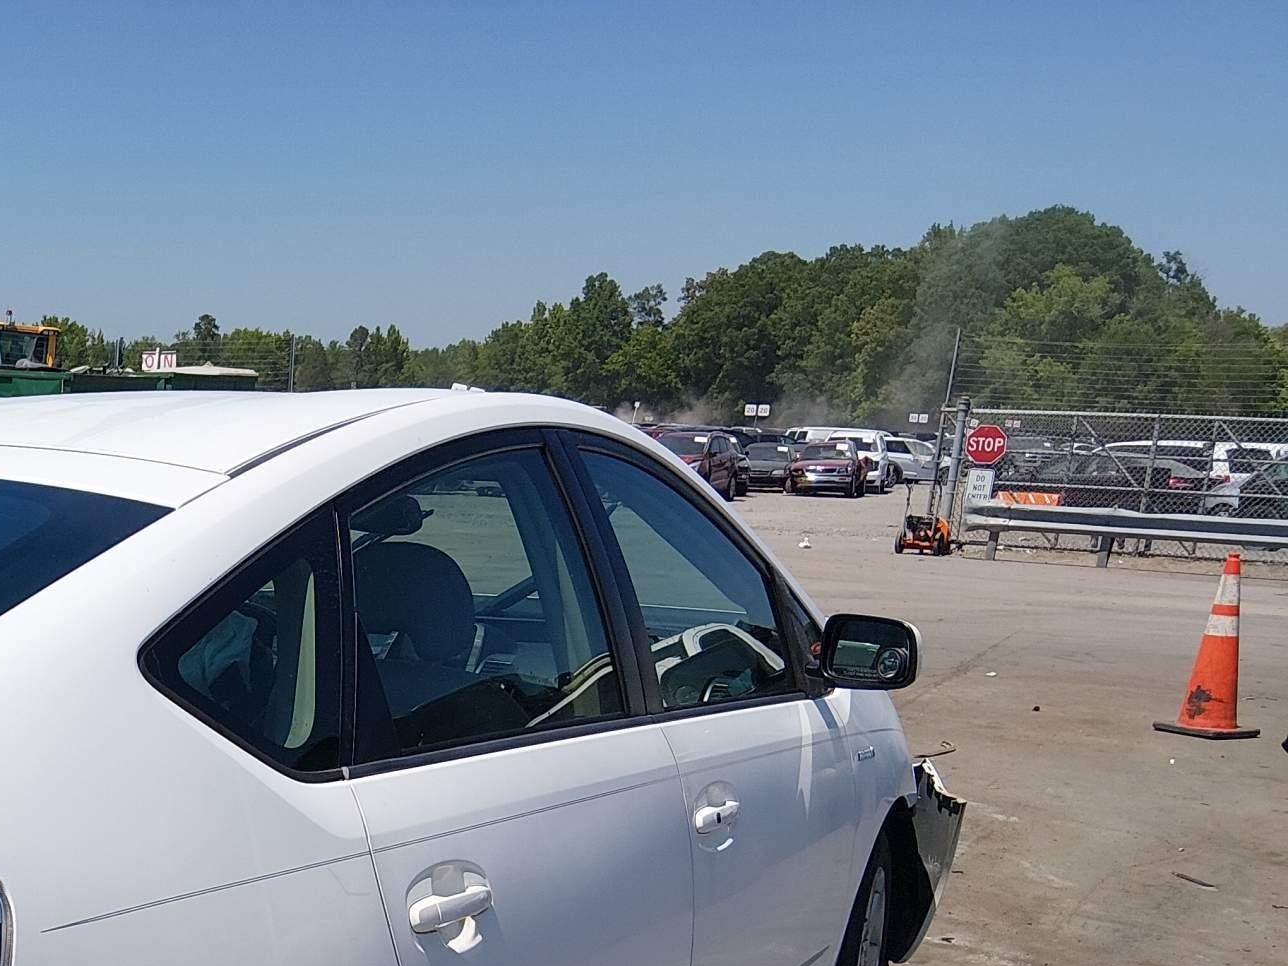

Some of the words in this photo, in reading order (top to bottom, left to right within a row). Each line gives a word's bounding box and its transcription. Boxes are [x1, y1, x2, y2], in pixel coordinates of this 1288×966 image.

[164, 354, 173, 368] N
[968, 437, 1004, 452] STOP
[972, 484, 986, 492] NOT
